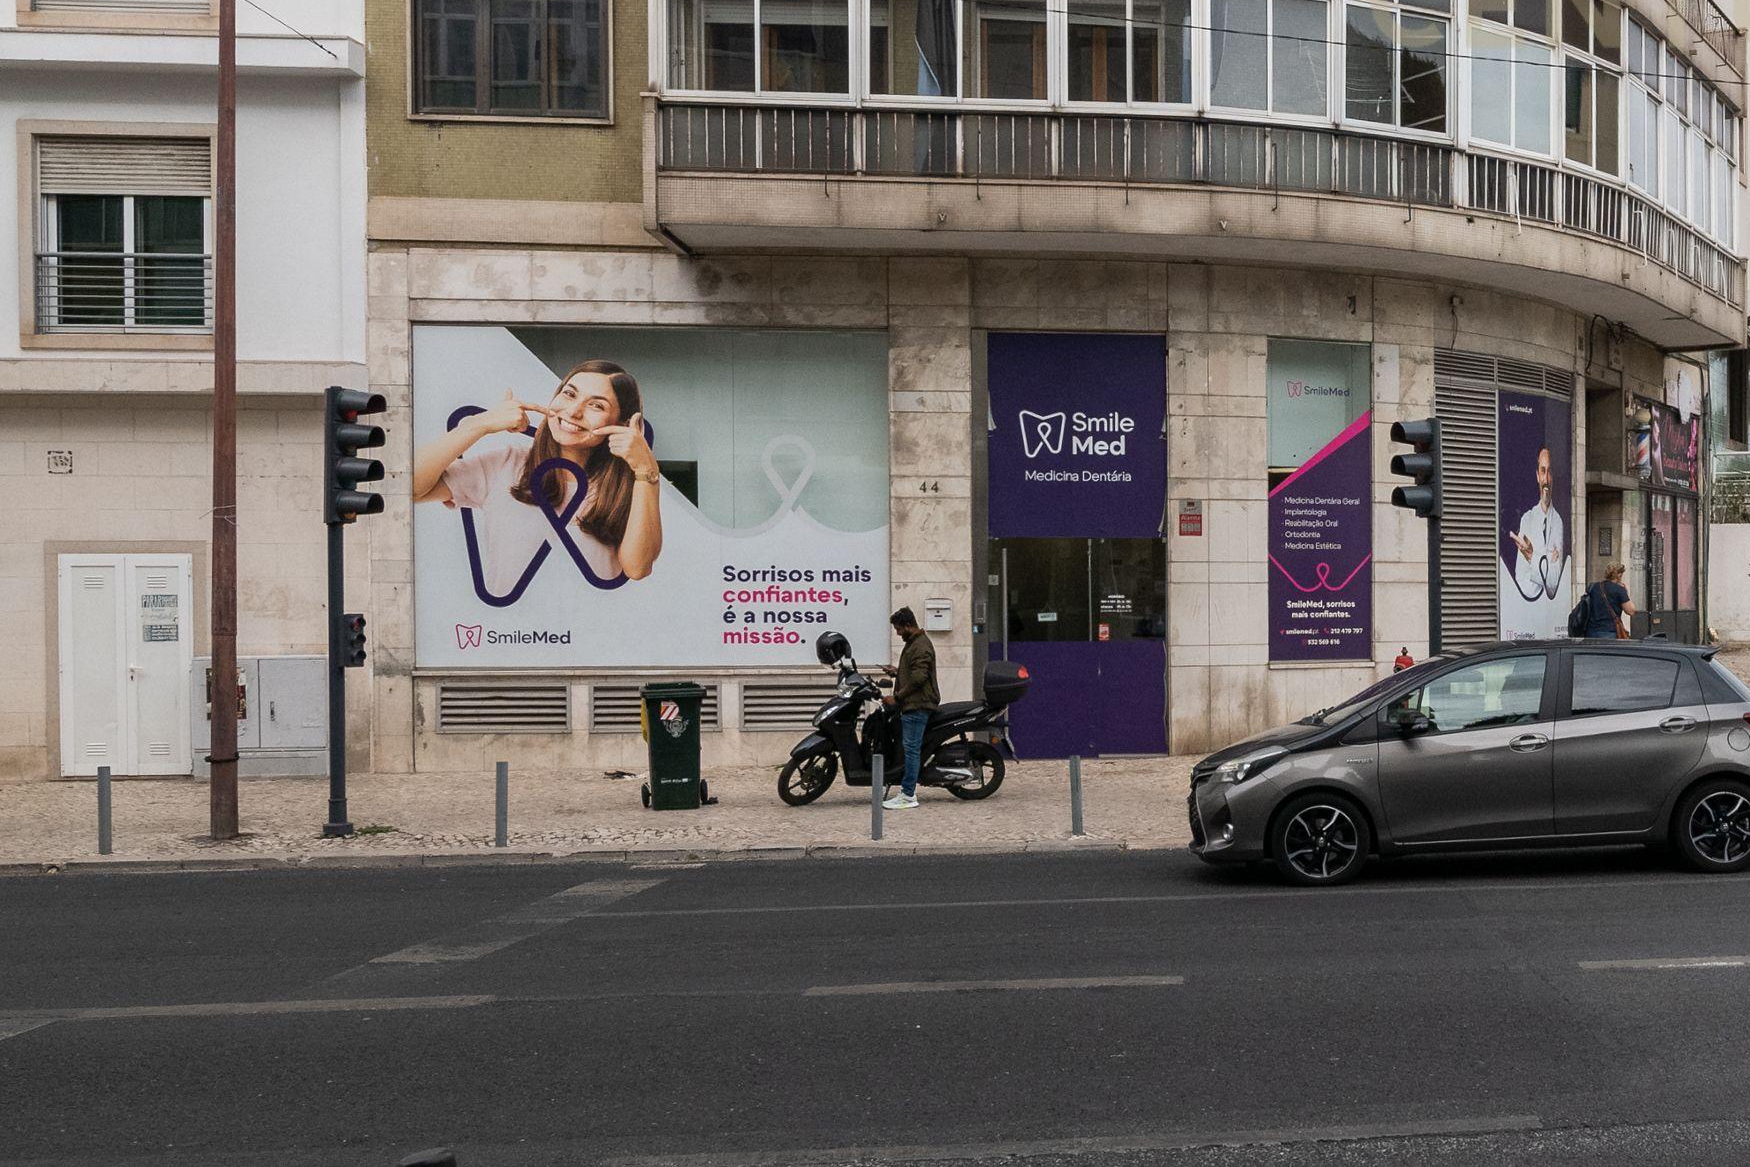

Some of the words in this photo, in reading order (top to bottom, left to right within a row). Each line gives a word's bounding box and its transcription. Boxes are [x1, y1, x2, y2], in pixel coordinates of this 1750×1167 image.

[1072, 411, 1135, 433] Smile
[1072, 434, 1126, 456] Med
[1025, 470, 1079, 482] Medicina
[1082, 469, 1132, 482] Dentária
[919, 481, 939, 494] 44
[1284, 497, 1314, 505] Medicina
[1342, 497, 1360, 506] Geral
[1284, 508, 1328, 517] Implantologia
[1284, 519, 1324, 528] Reabilitação
[1325, 519, 1339, 527] Oral
[1284, 542, 1315, 550] Medicina
[1315, 542, 1342, 550] Estética
[722, 565, 815, 583] Sorrisos
[822, 565, 872, 583] mais
[722, 585, 849, 606] confiantes,
[1326, 600, 1356, 608] sorrisos
[722, 605, 737, 623] é
[743, 610, 756, 623] a
[763, 610, 828, 623] nossa
[1309, 610, 1352, 618] confiantes.
[487, 630, 572, 645] SmileMed
[722, 626, 806, 644] missão.
